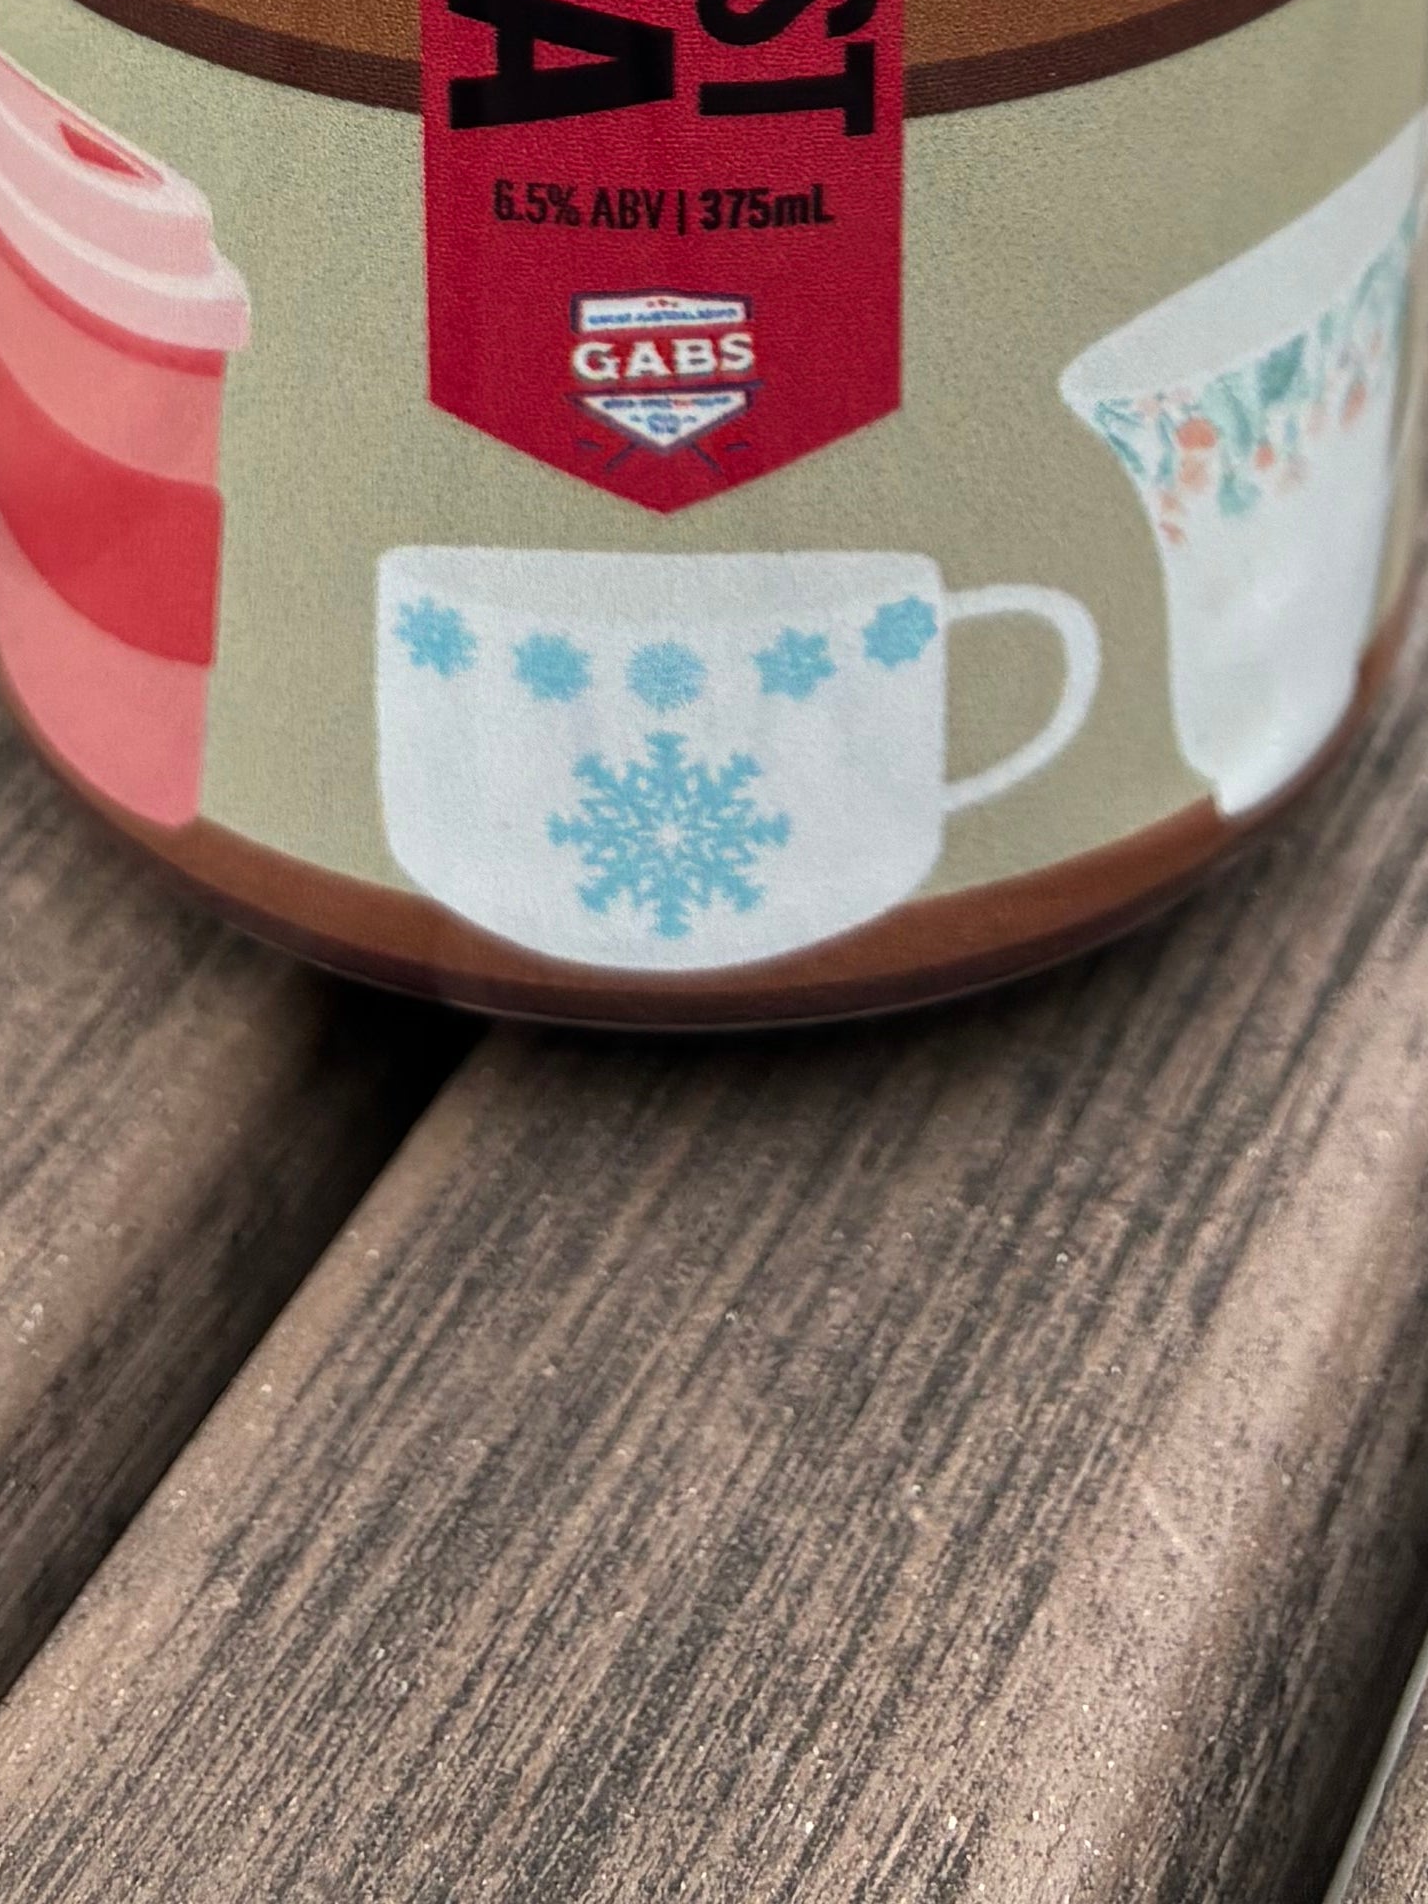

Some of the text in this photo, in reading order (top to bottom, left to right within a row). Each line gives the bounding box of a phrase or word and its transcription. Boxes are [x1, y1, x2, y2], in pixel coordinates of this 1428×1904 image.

[492, 178, 581, 228] 6.5%
[590, 187, 665, 230] ABV
[698, 183, 834, 231] 375mL
[572, 331, 756, 381] GABS
